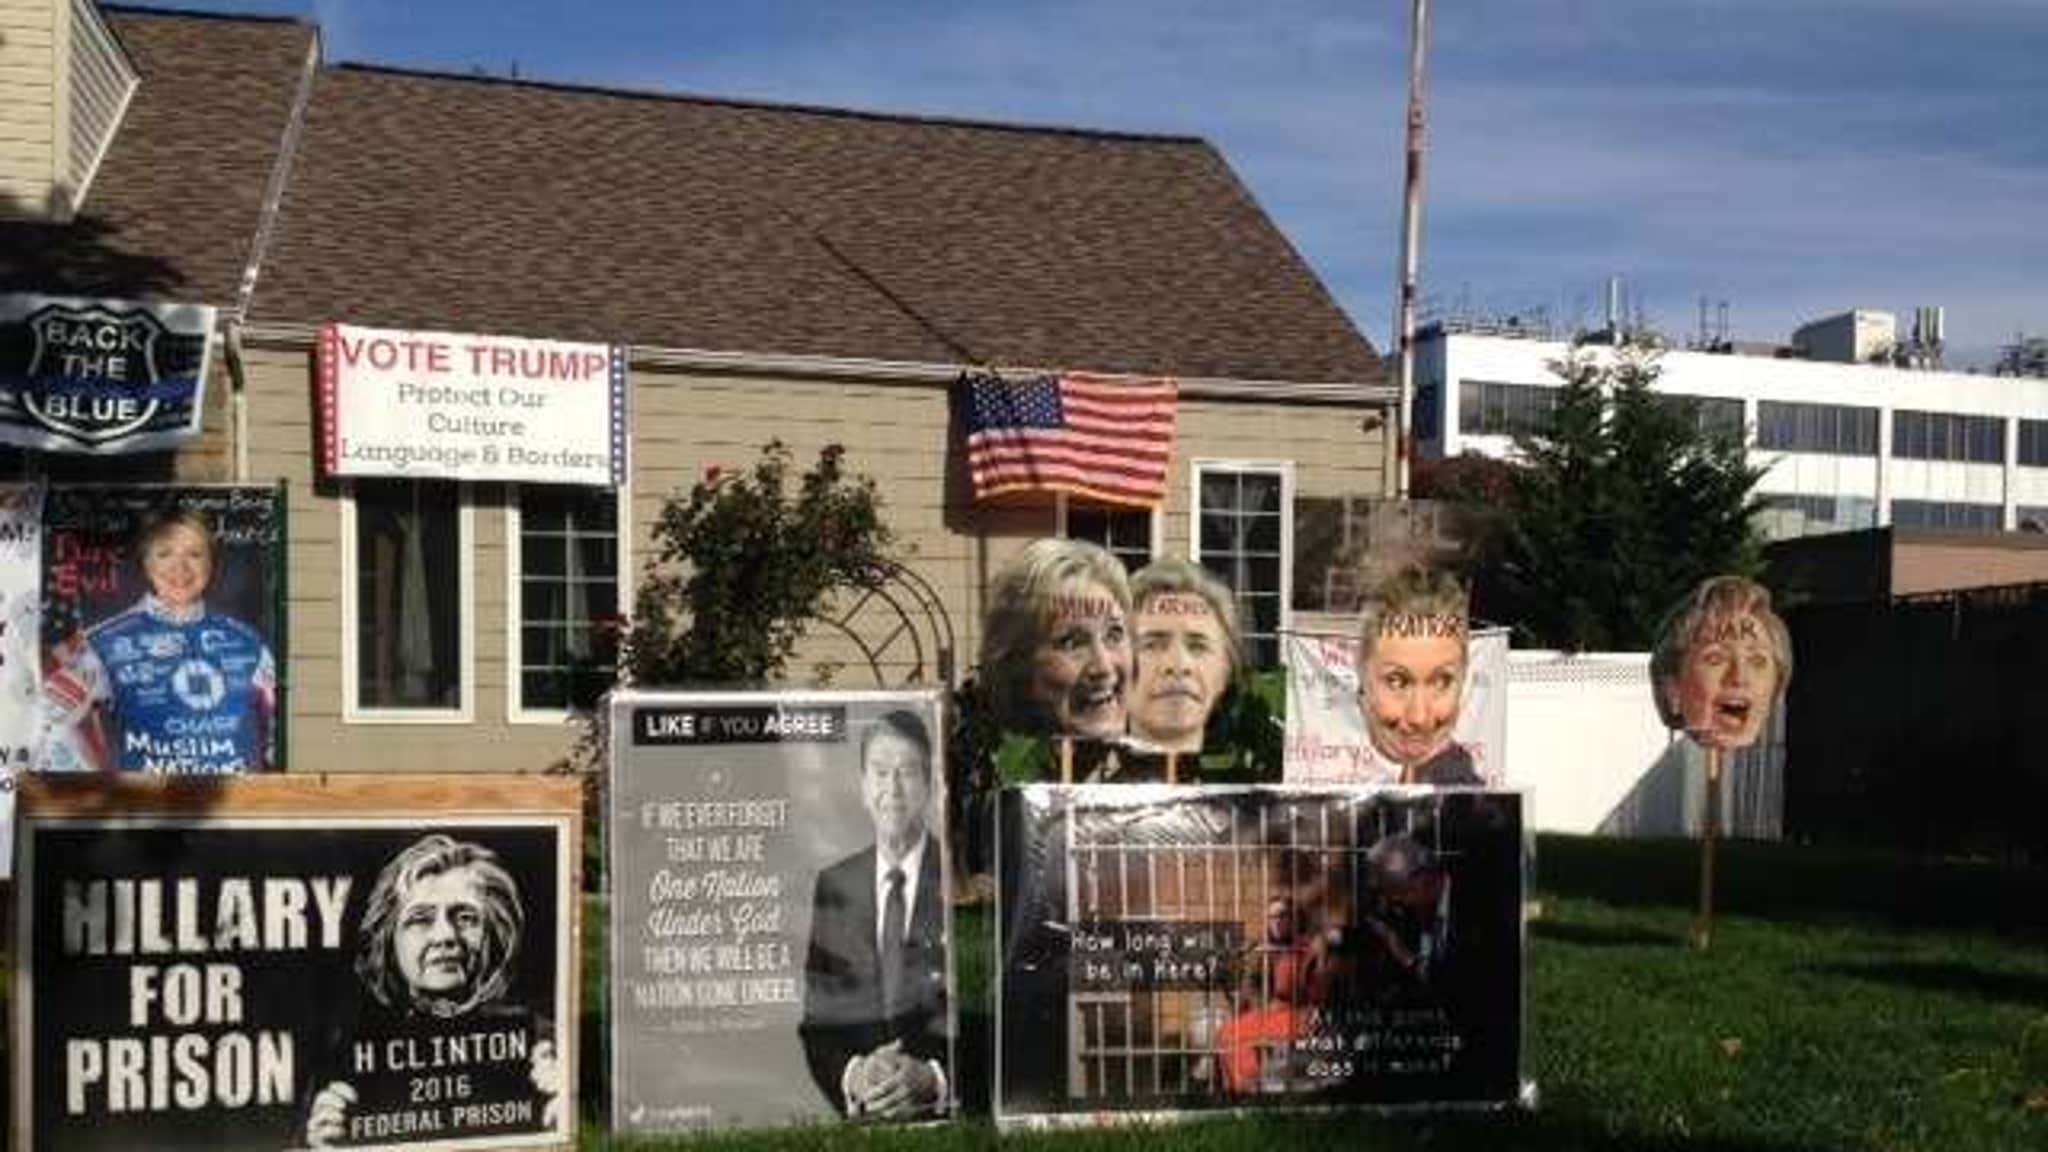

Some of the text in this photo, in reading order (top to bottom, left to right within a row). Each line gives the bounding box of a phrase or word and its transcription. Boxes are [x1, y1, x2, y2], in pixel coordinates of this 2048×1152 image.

[46, 321, 143, 350] BACK
[61, 354, 128, 380] THE
[339, 336, 606, 381] VOTE TRUMP
[46, 395, 138, 421] BLUE
[397, 382, 547, 408] Protect Our
[427, 412, 526, 436] Culture
[341, 438, 477, 467] Language
[646, 715, 694, 736] LIKE
[719, 716, 759, 735] YOU
[764, 714, 832, 735] AGREE
[62, 876, 353, 955] HILLARY
[1072, 930, 1115, 952] How
[1125, 929, 1172, 957] long
[129, 962, 244, 1027] FOR
[353, 1029, 527, 1073] H CLINTON
[67, 1030, 294, 1115] PRISON
[409, 1075, 472, 1102] 2016
[351, 1100, 533, 1139] FEDERAL PRISON
